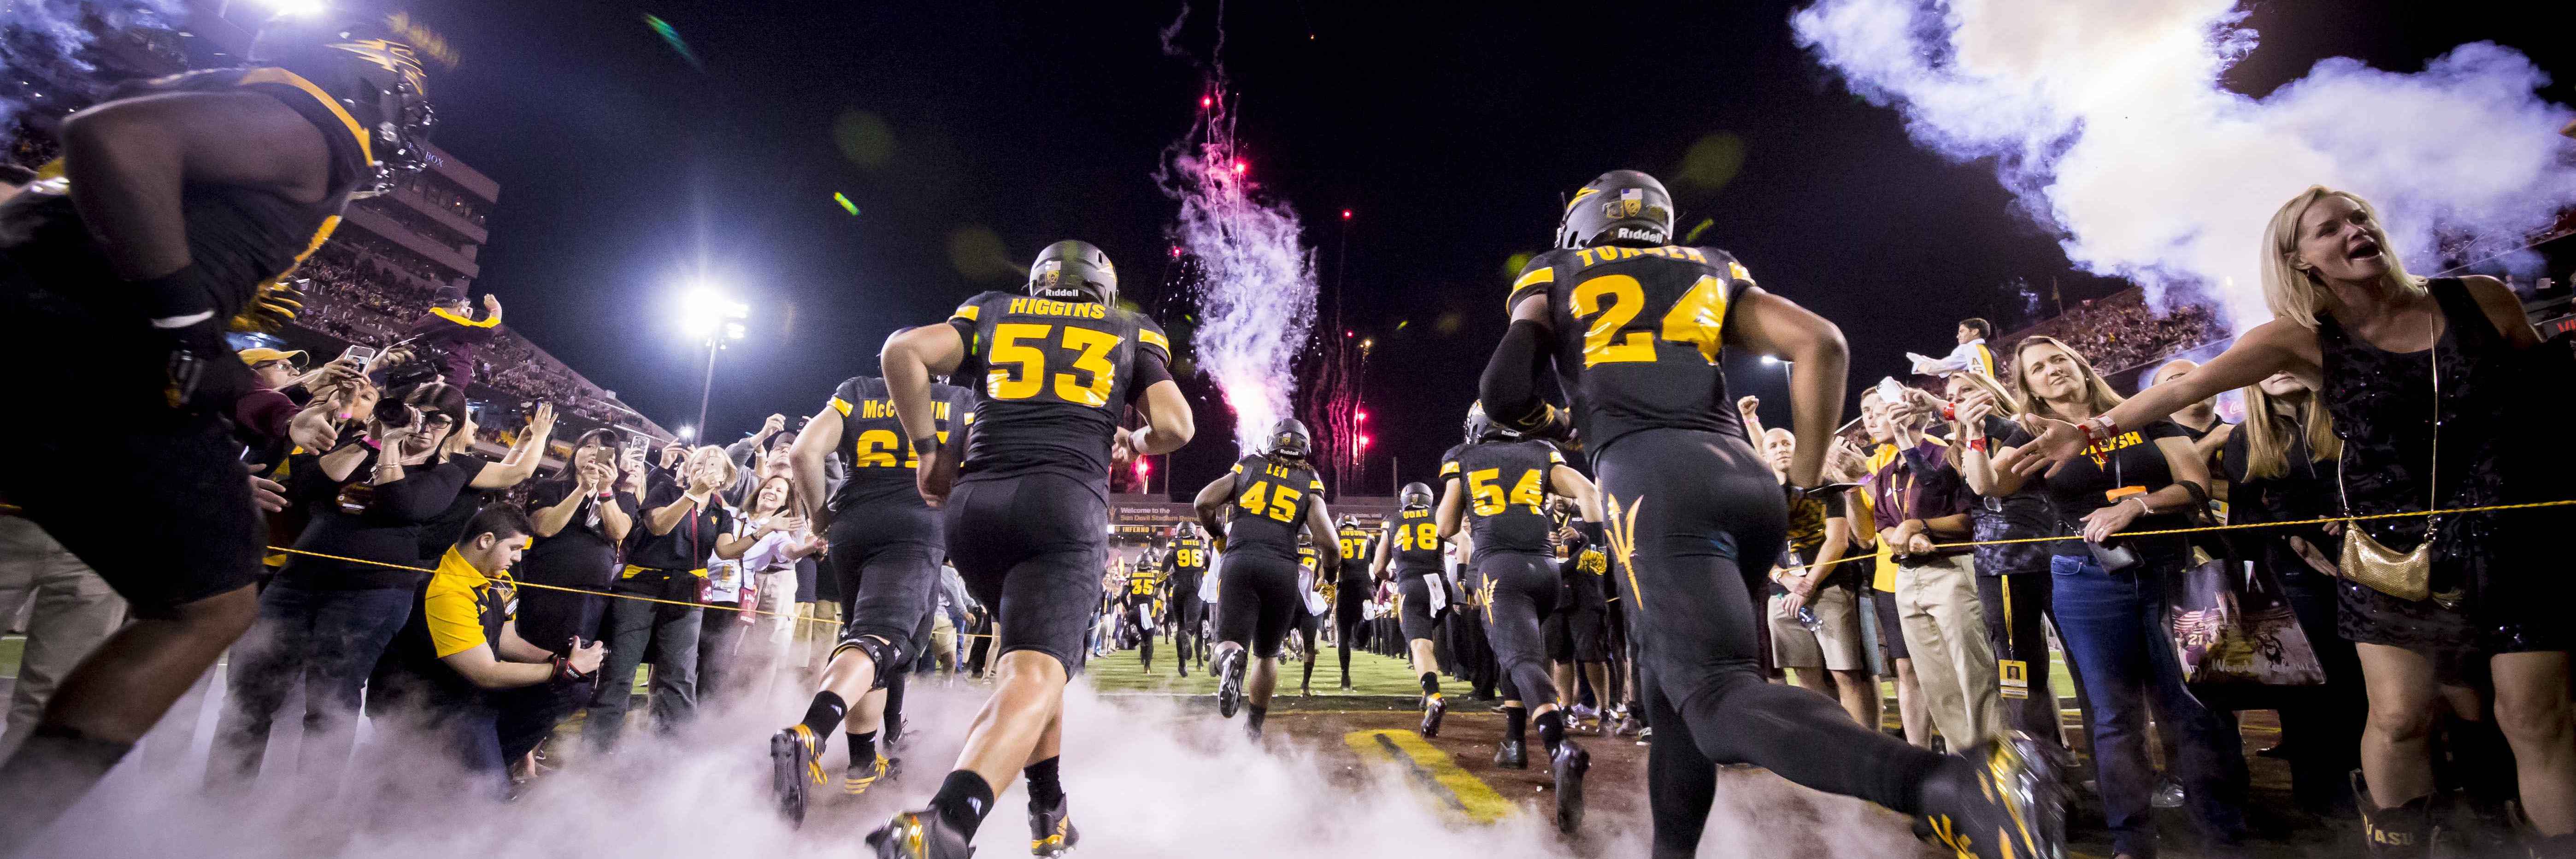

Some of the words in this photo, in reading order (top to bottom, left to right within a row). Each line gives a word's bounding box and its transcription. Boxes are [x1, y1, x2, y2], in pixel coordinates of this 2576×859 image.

[426, 151, 443, 167] BOX
[1618, 228, 1663, 243] Riddell
[1009, 298, 1106, 319] HIGGINS
[1570, 274, 1727, 369] 24
[987, 324, 1124, 407] 53
[1266, 463, 1288, 479] LEA
[1240, 480, 1303, 523] 45
[1467, 468, 1544, 516] 54
[1394, 523, 1438, 551] 48
[1340, 538, 1367, 559] 87
[1131, 579, 1155, 595] 35
[2188, 634, 2203, 646] 21
